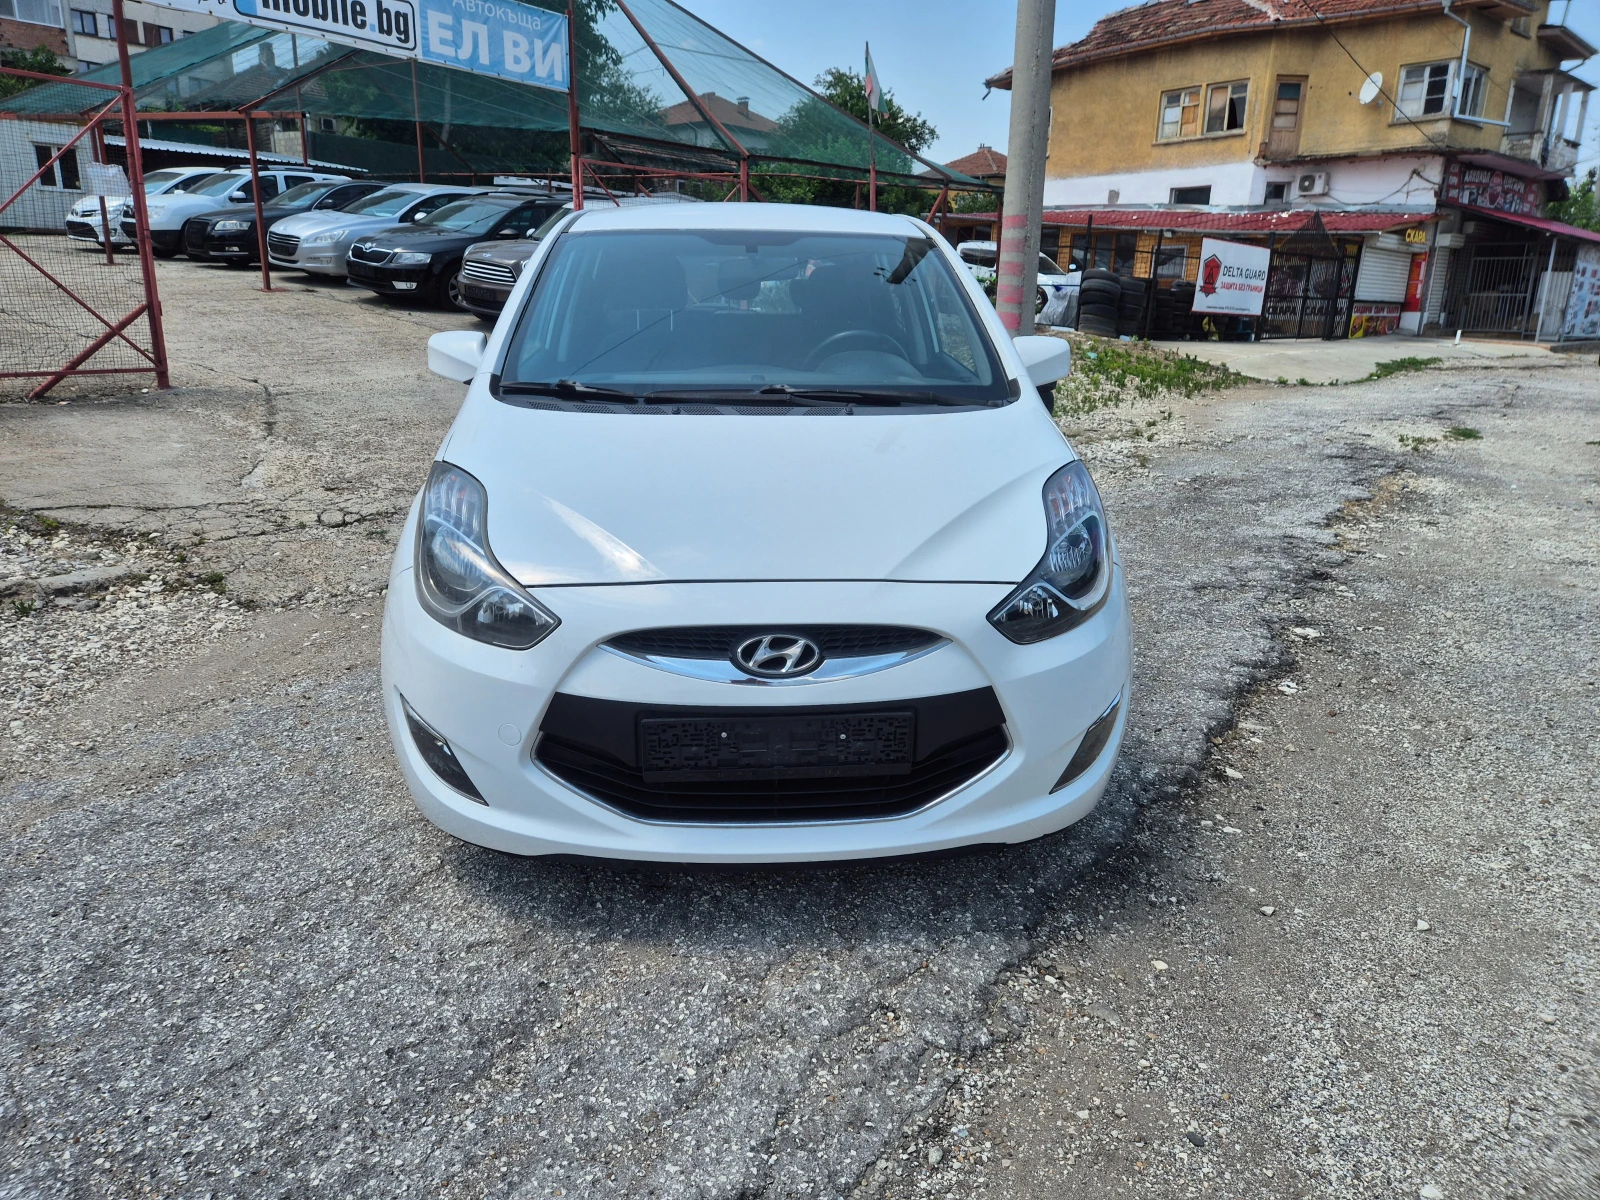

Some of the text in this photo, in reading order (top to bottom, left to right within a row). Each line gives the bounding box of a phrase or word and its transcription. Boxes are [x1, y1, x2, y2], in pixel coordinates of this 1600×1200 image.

[427, 9, 563, 82] ЕЛ ВИ
[1405, 228, 1427, 244] СКАРА
[1222, 265, 1266, 281] DELTA GUARD
[1220, 281, 1238, 291] ЗАЩИТА
[1238, 283, 1246, 291] БЕЗ
